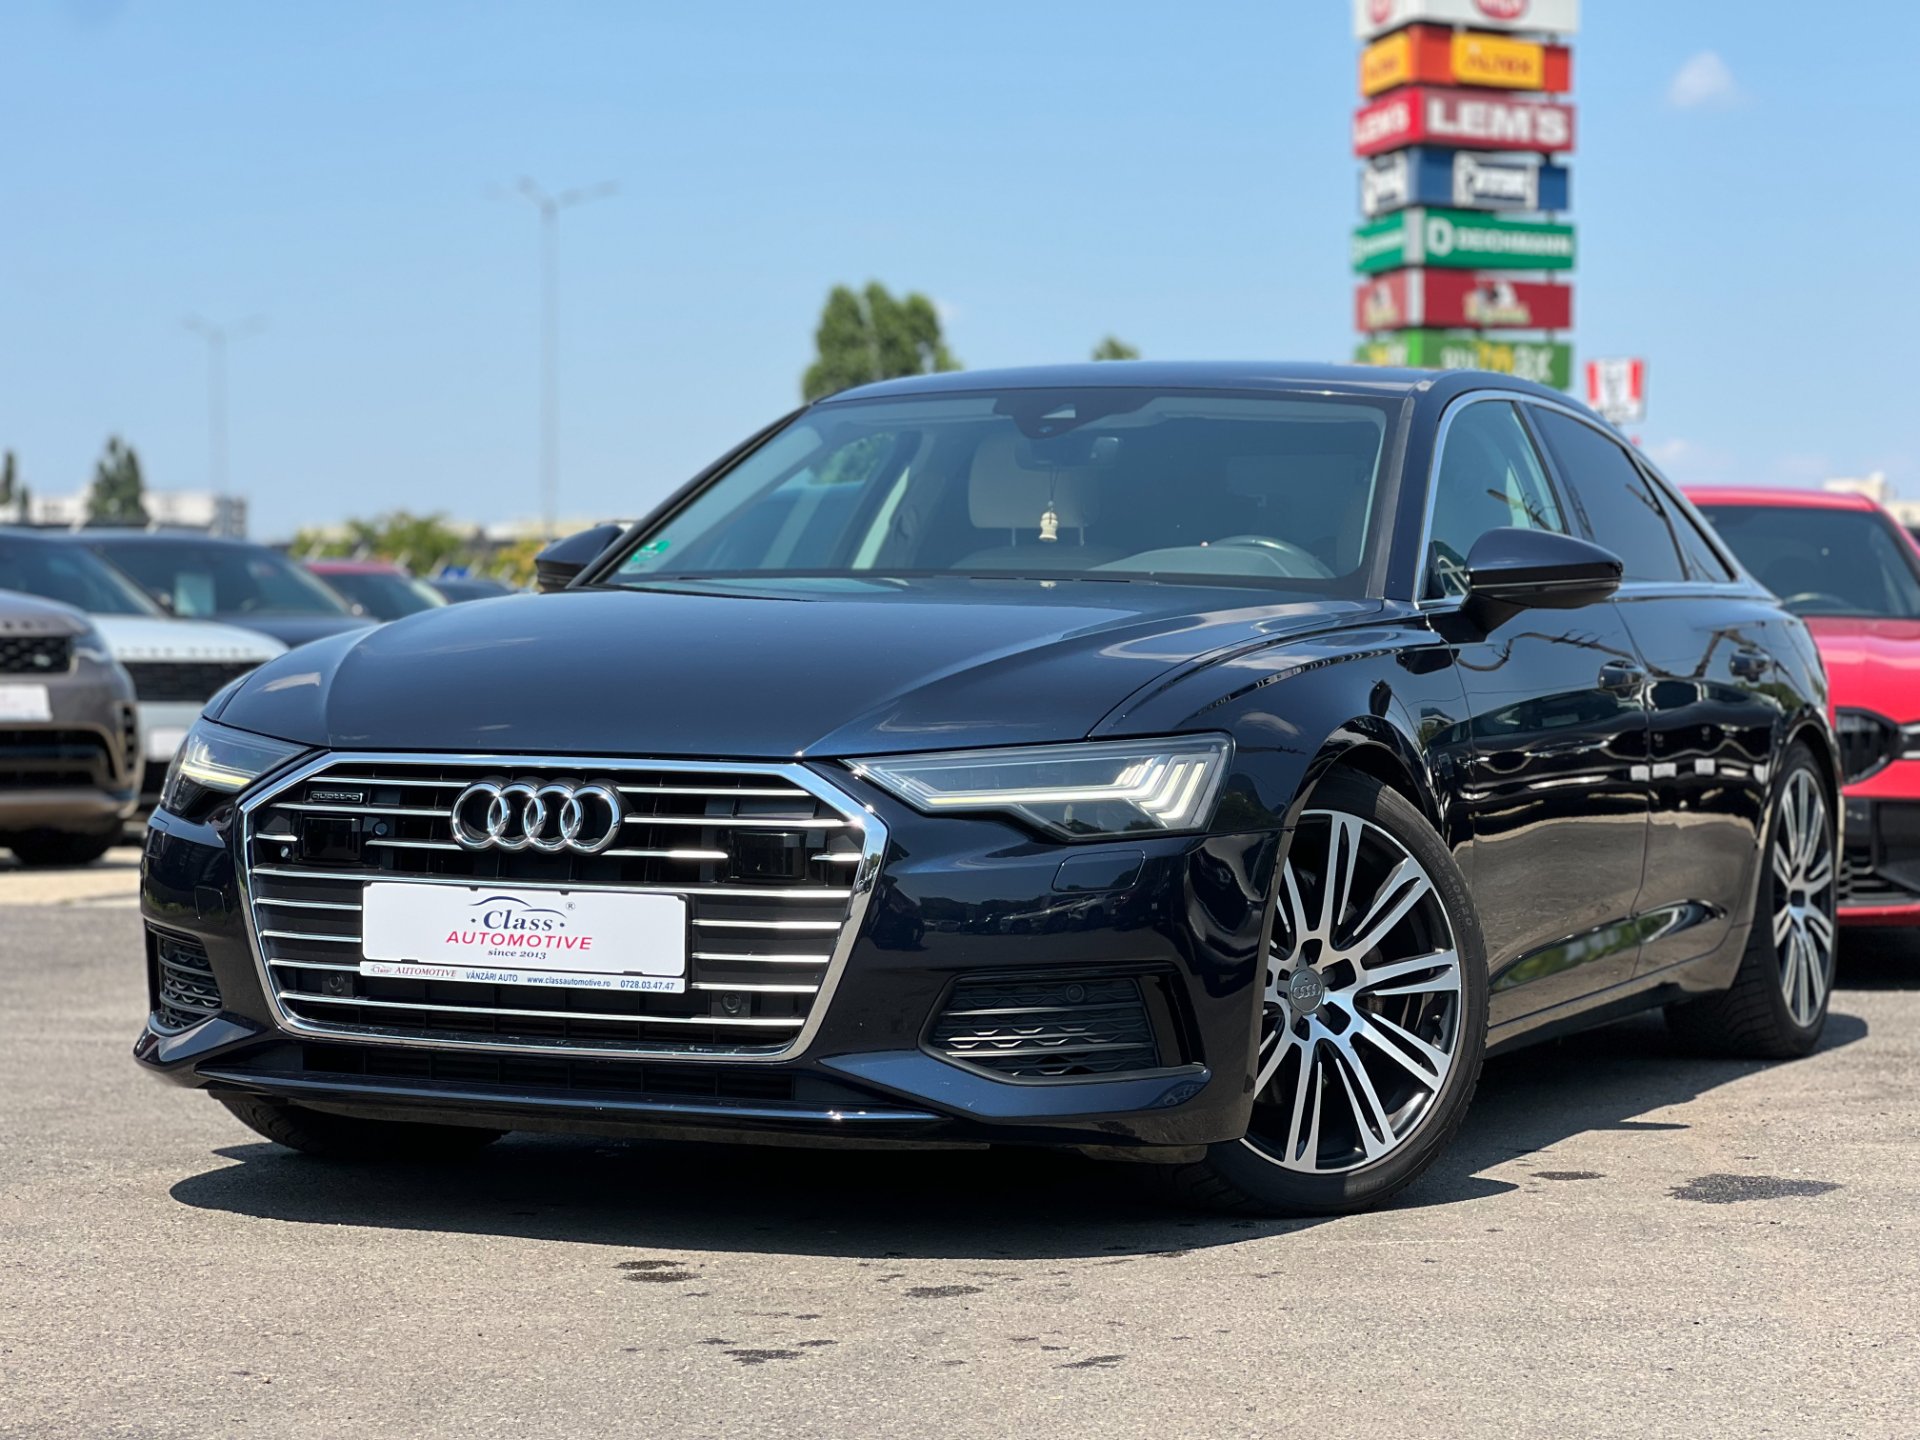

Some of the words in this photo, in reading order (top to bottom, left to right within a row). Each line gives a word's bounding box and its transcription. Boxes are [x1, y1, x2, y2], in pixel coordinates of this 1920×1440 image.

[312, 792, 360, 801] quattro
[483, 909, 553, 931] Class
[446, 930, 592, 950] AUTOMOTIVE
[488, 948, 517, 957] since
[520, 950, 547, 960] 2013
[395, 966, 457, 978] AUTOMOTIVE
[498, 973, 518, 982] AUTO
[527, 974, 611, 987] www.classautomotive.ro
[620, 979, 675, 991] 0728.03.47.47
